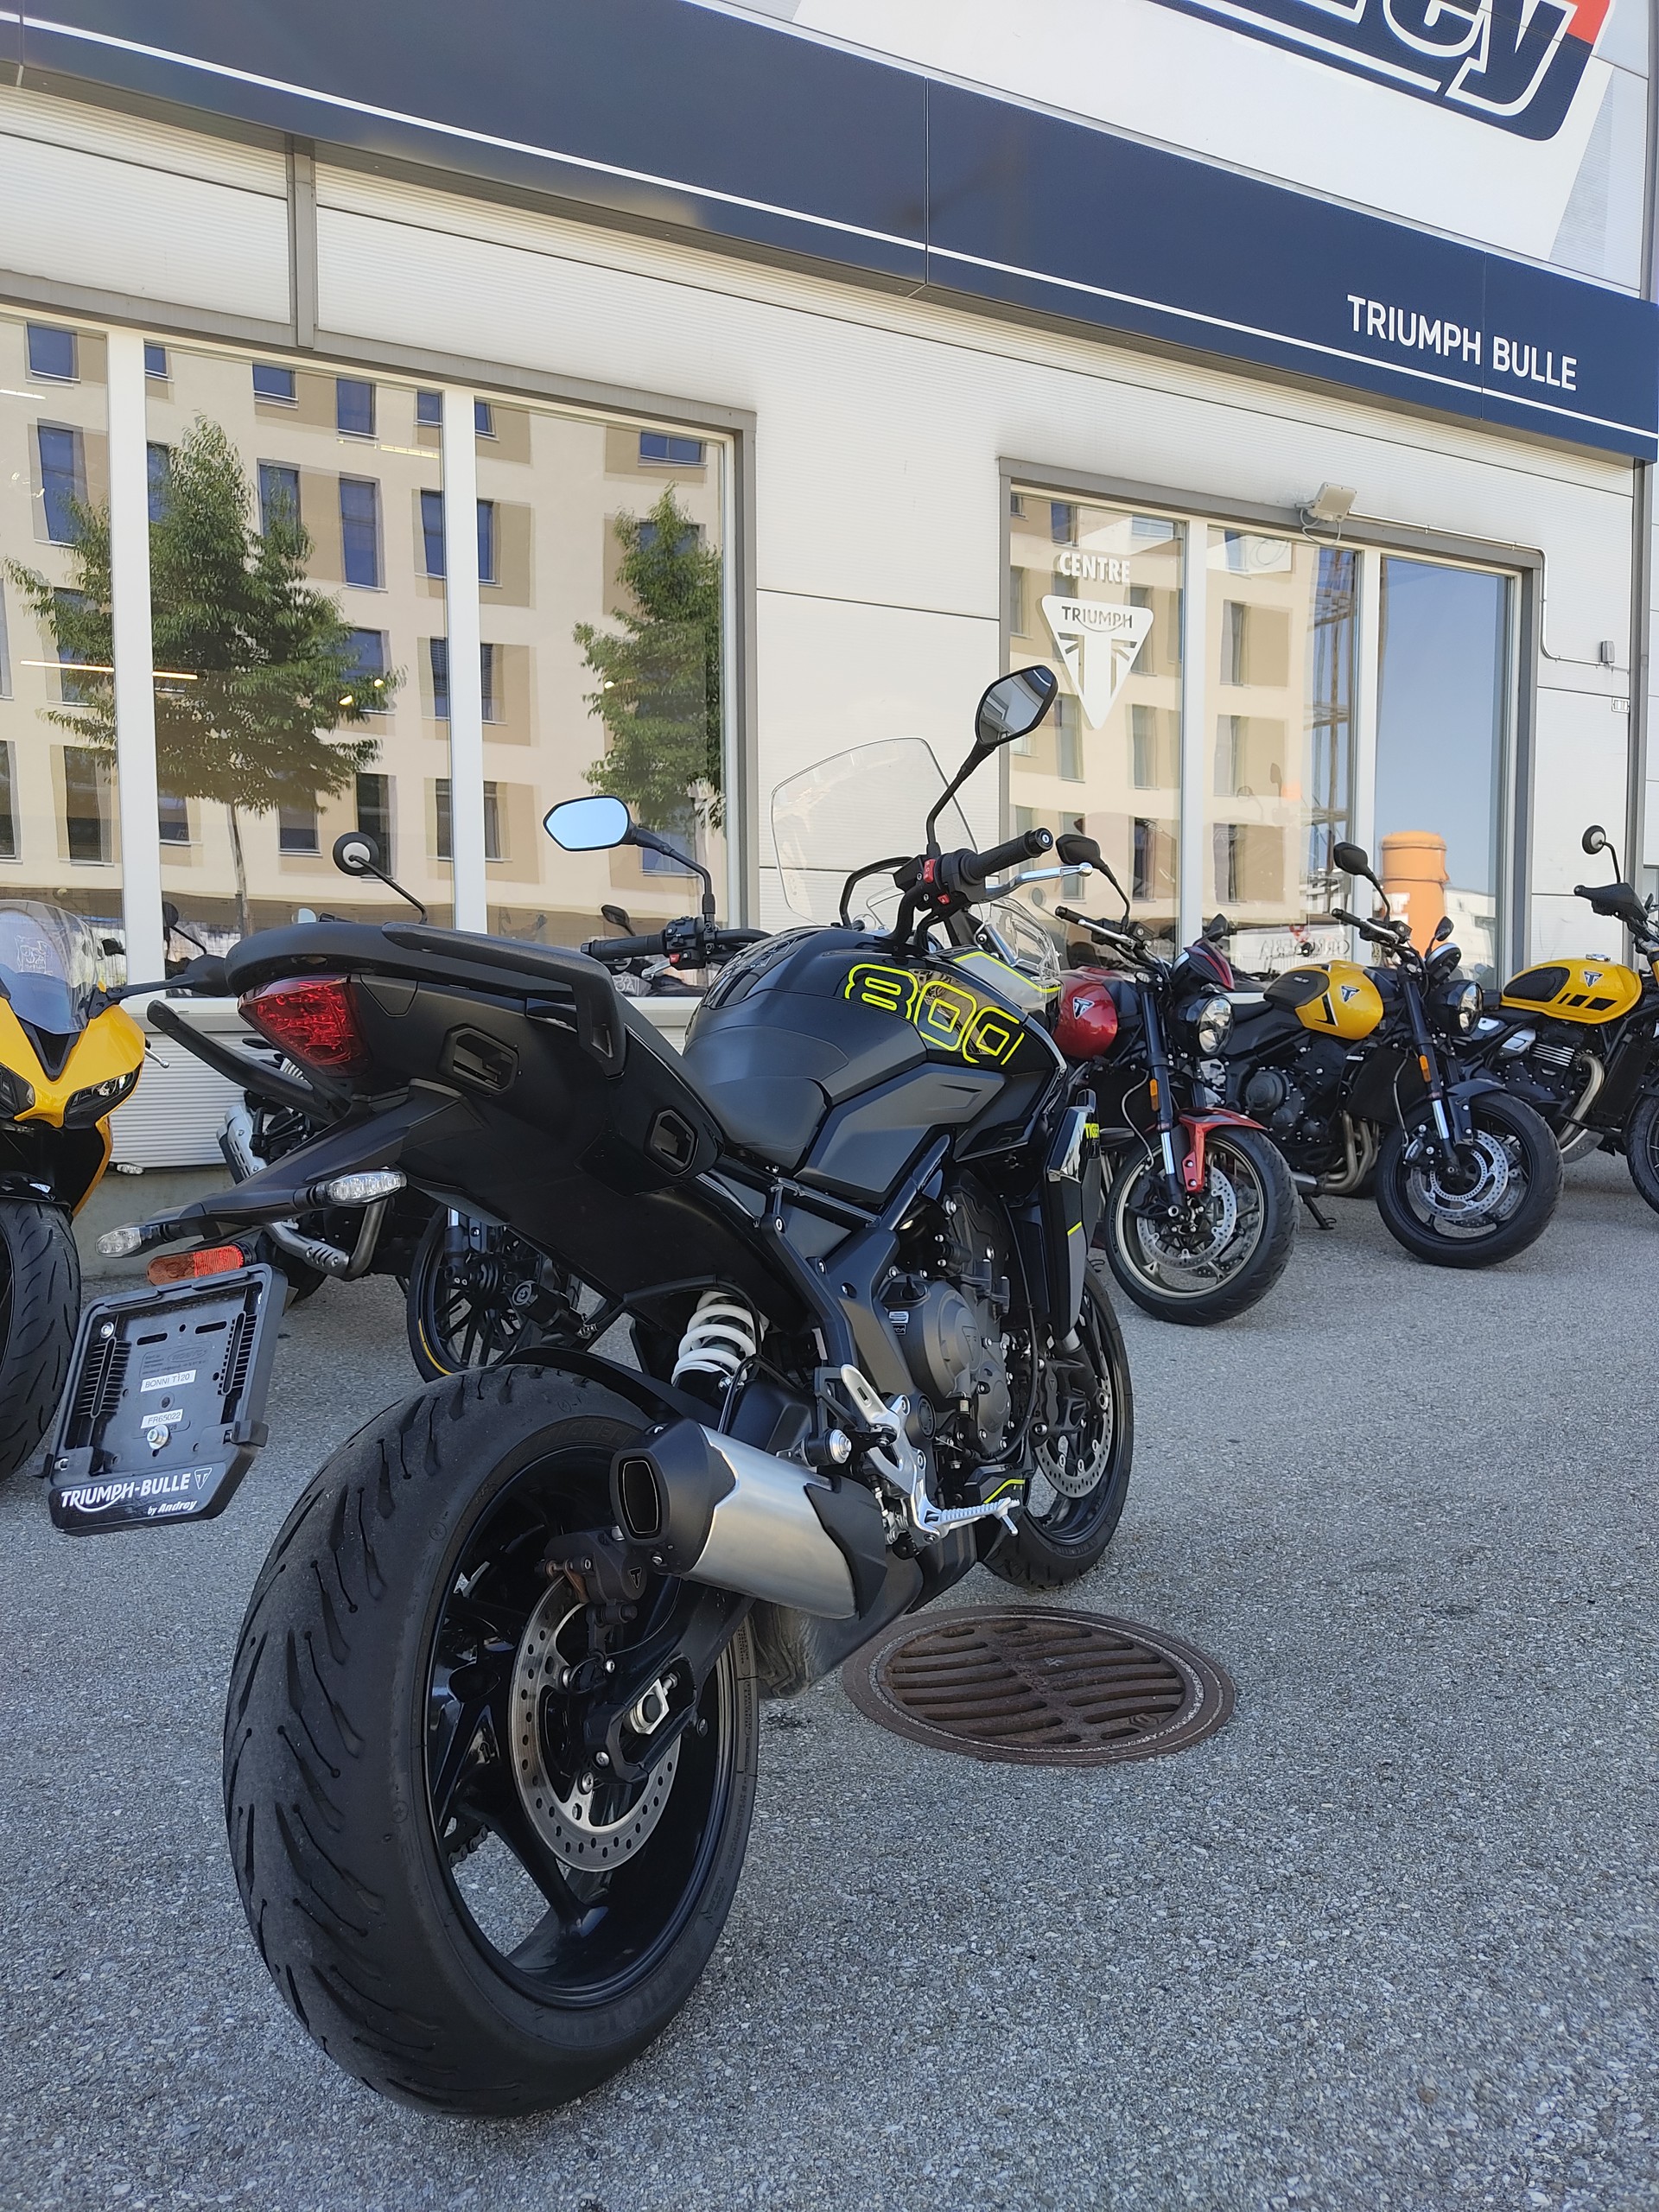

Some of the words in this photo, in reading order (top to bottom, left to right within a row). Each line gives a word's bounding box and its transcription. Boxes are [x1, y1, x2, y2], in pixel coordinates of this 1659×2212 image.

[1347, 294, 1482, 365] TRIUMPH
[1492, 335, 1578, 391] BULLE
[1059, 551, 1131, 583] CENTRE
[1061, 605, 1134, 632] TRIUMPH
[843, 963, 1026, 1065] 800
[61, 1472, 191, 1511] TRIUMPH-BULLE
[147, 1505, 157, 1516] by
[157, 1500, 198, 1513] Andrey
